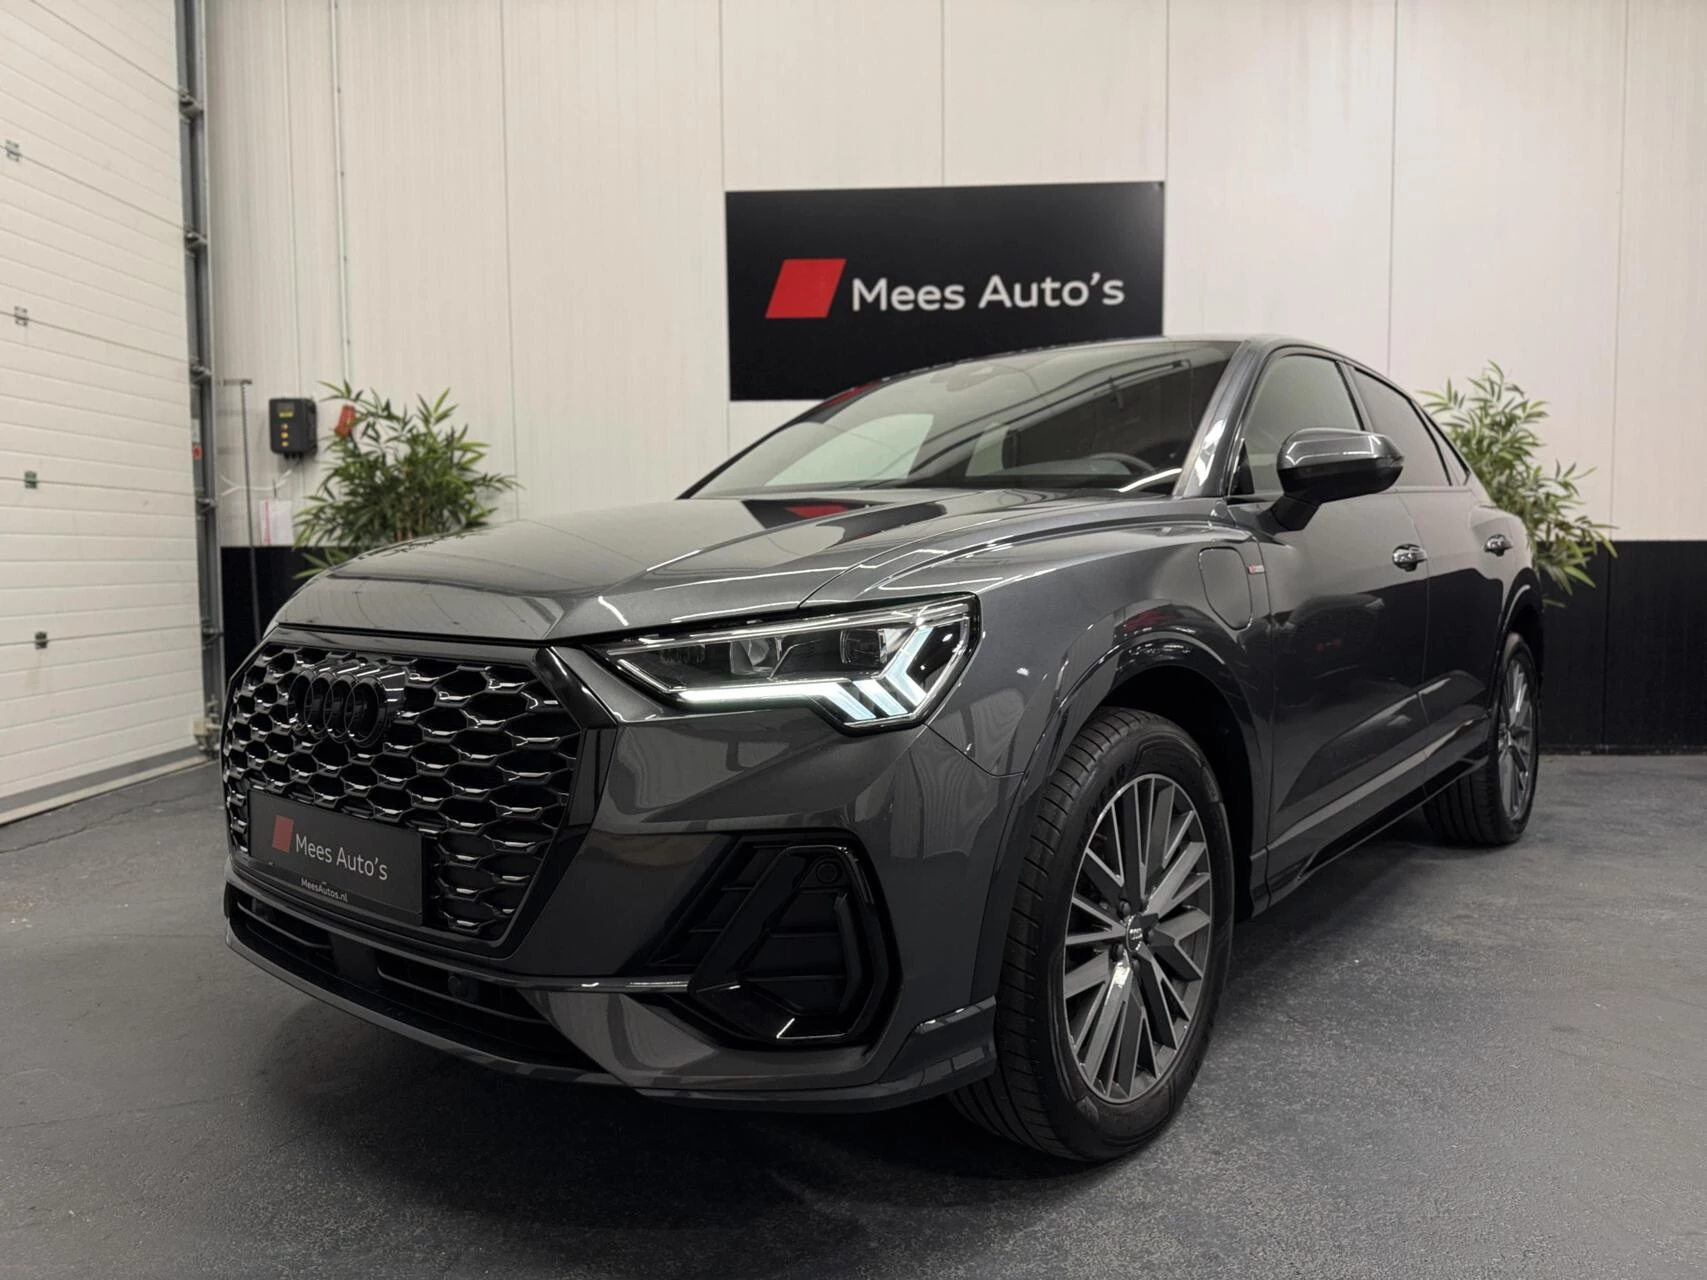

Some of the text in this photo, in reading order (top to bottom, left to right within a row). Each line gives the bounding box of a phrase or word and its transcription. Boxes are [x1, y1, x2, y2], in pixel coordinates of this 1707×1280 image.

[852, 272, 1126, 312] Mees Auto's
[295, 833, 388, 881] Mees Auto's
[301, 877, 348, 903] MeesAutos.nl
